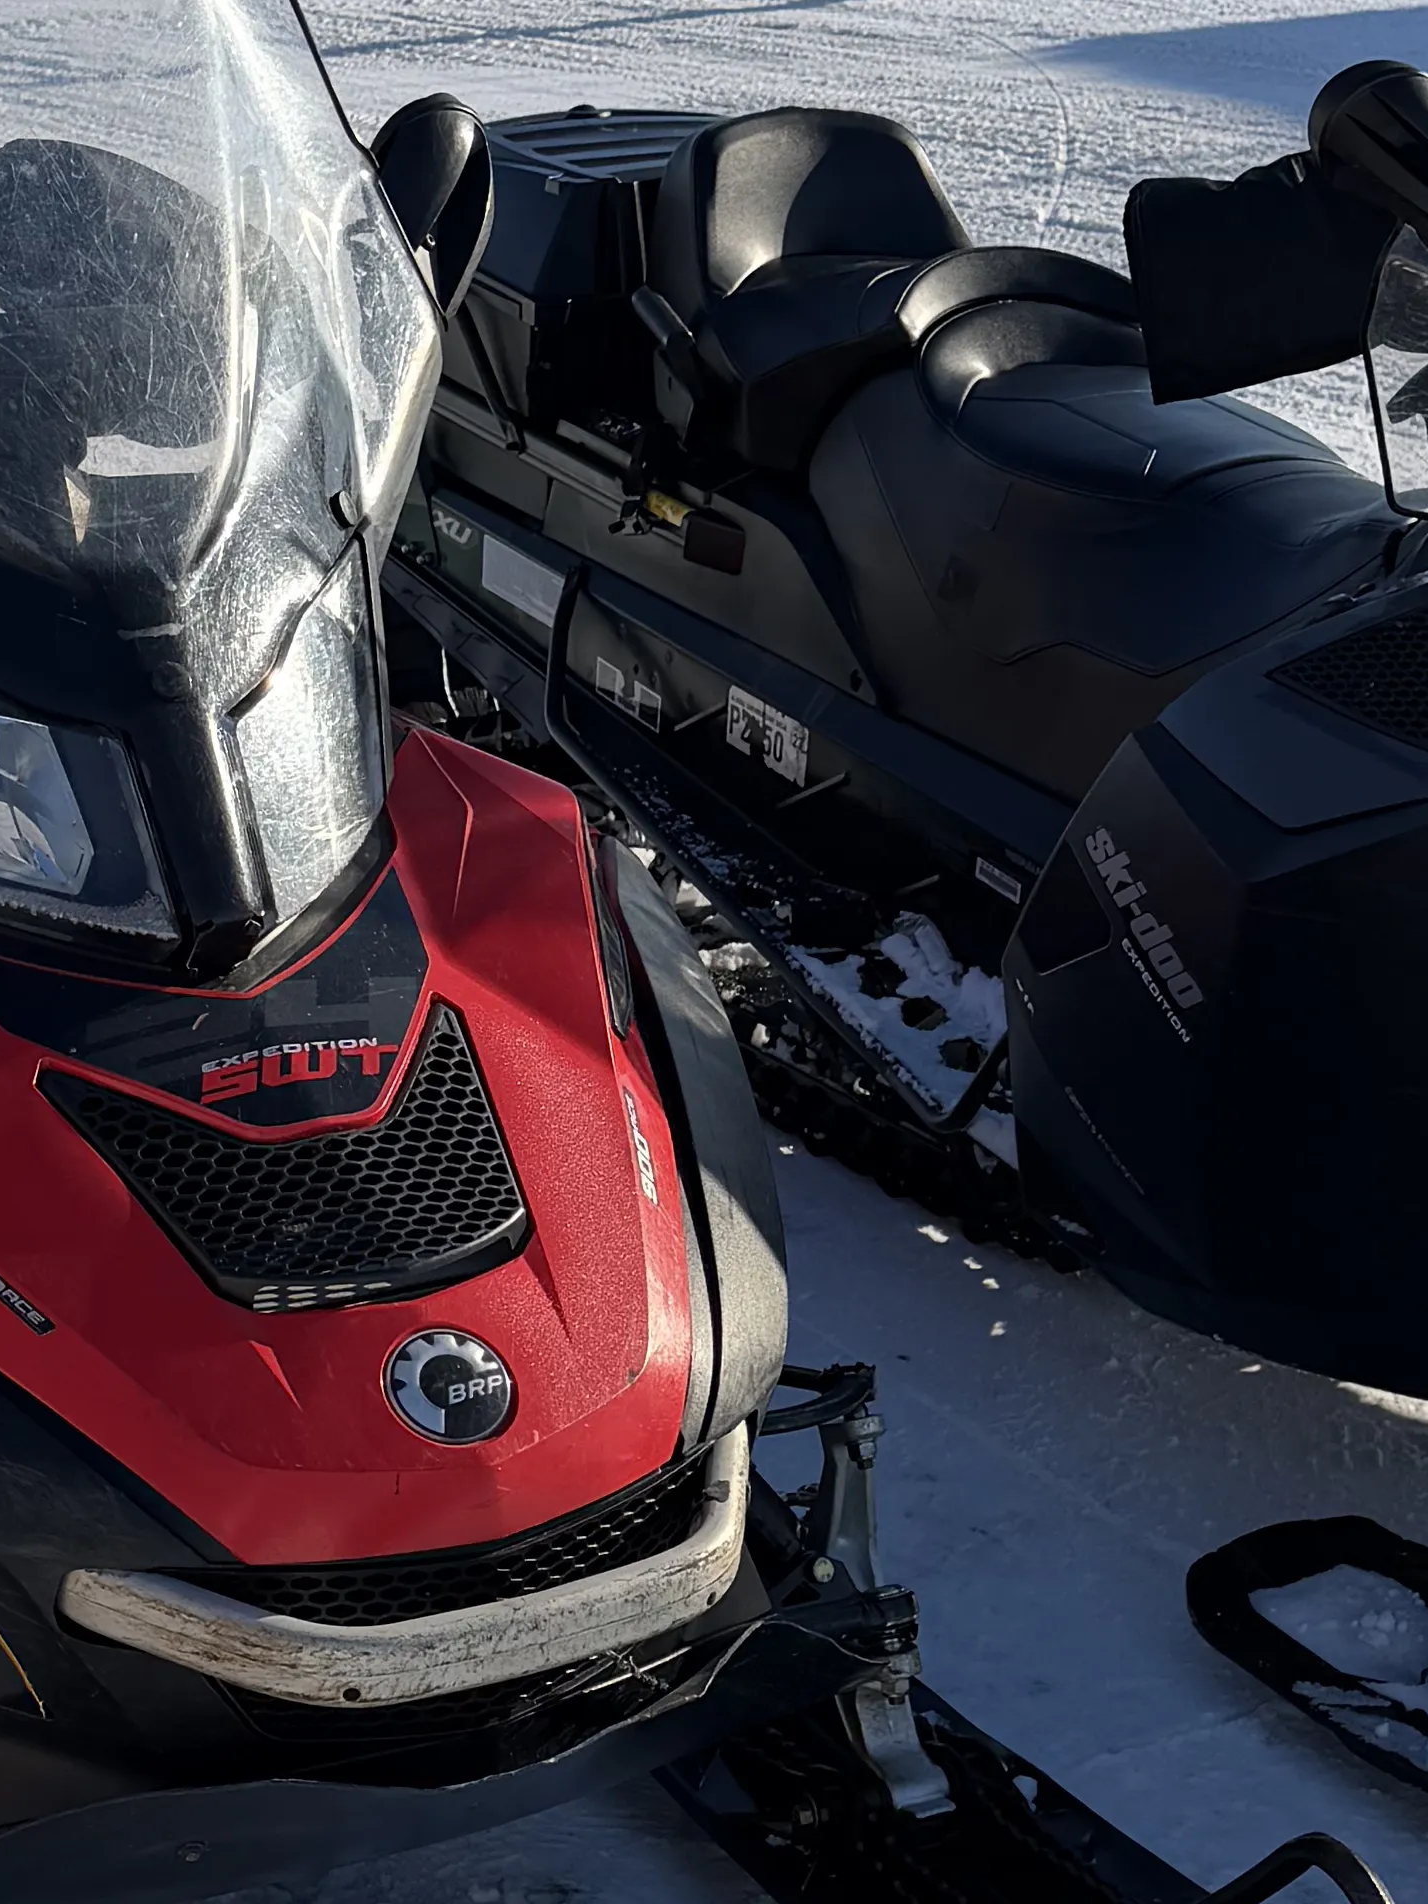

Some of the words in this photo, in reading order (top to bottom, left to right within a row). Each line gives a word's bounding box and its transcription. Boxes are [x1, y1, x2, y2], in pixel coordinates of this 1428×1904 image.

[1121, 937, 1191, 1044] EXPEDITION
[200, 1044, 398, 1104] SWT
[201, 1037, 378, 1073] EXPEDITION
[448, 1374, 504, 1405] BRP
